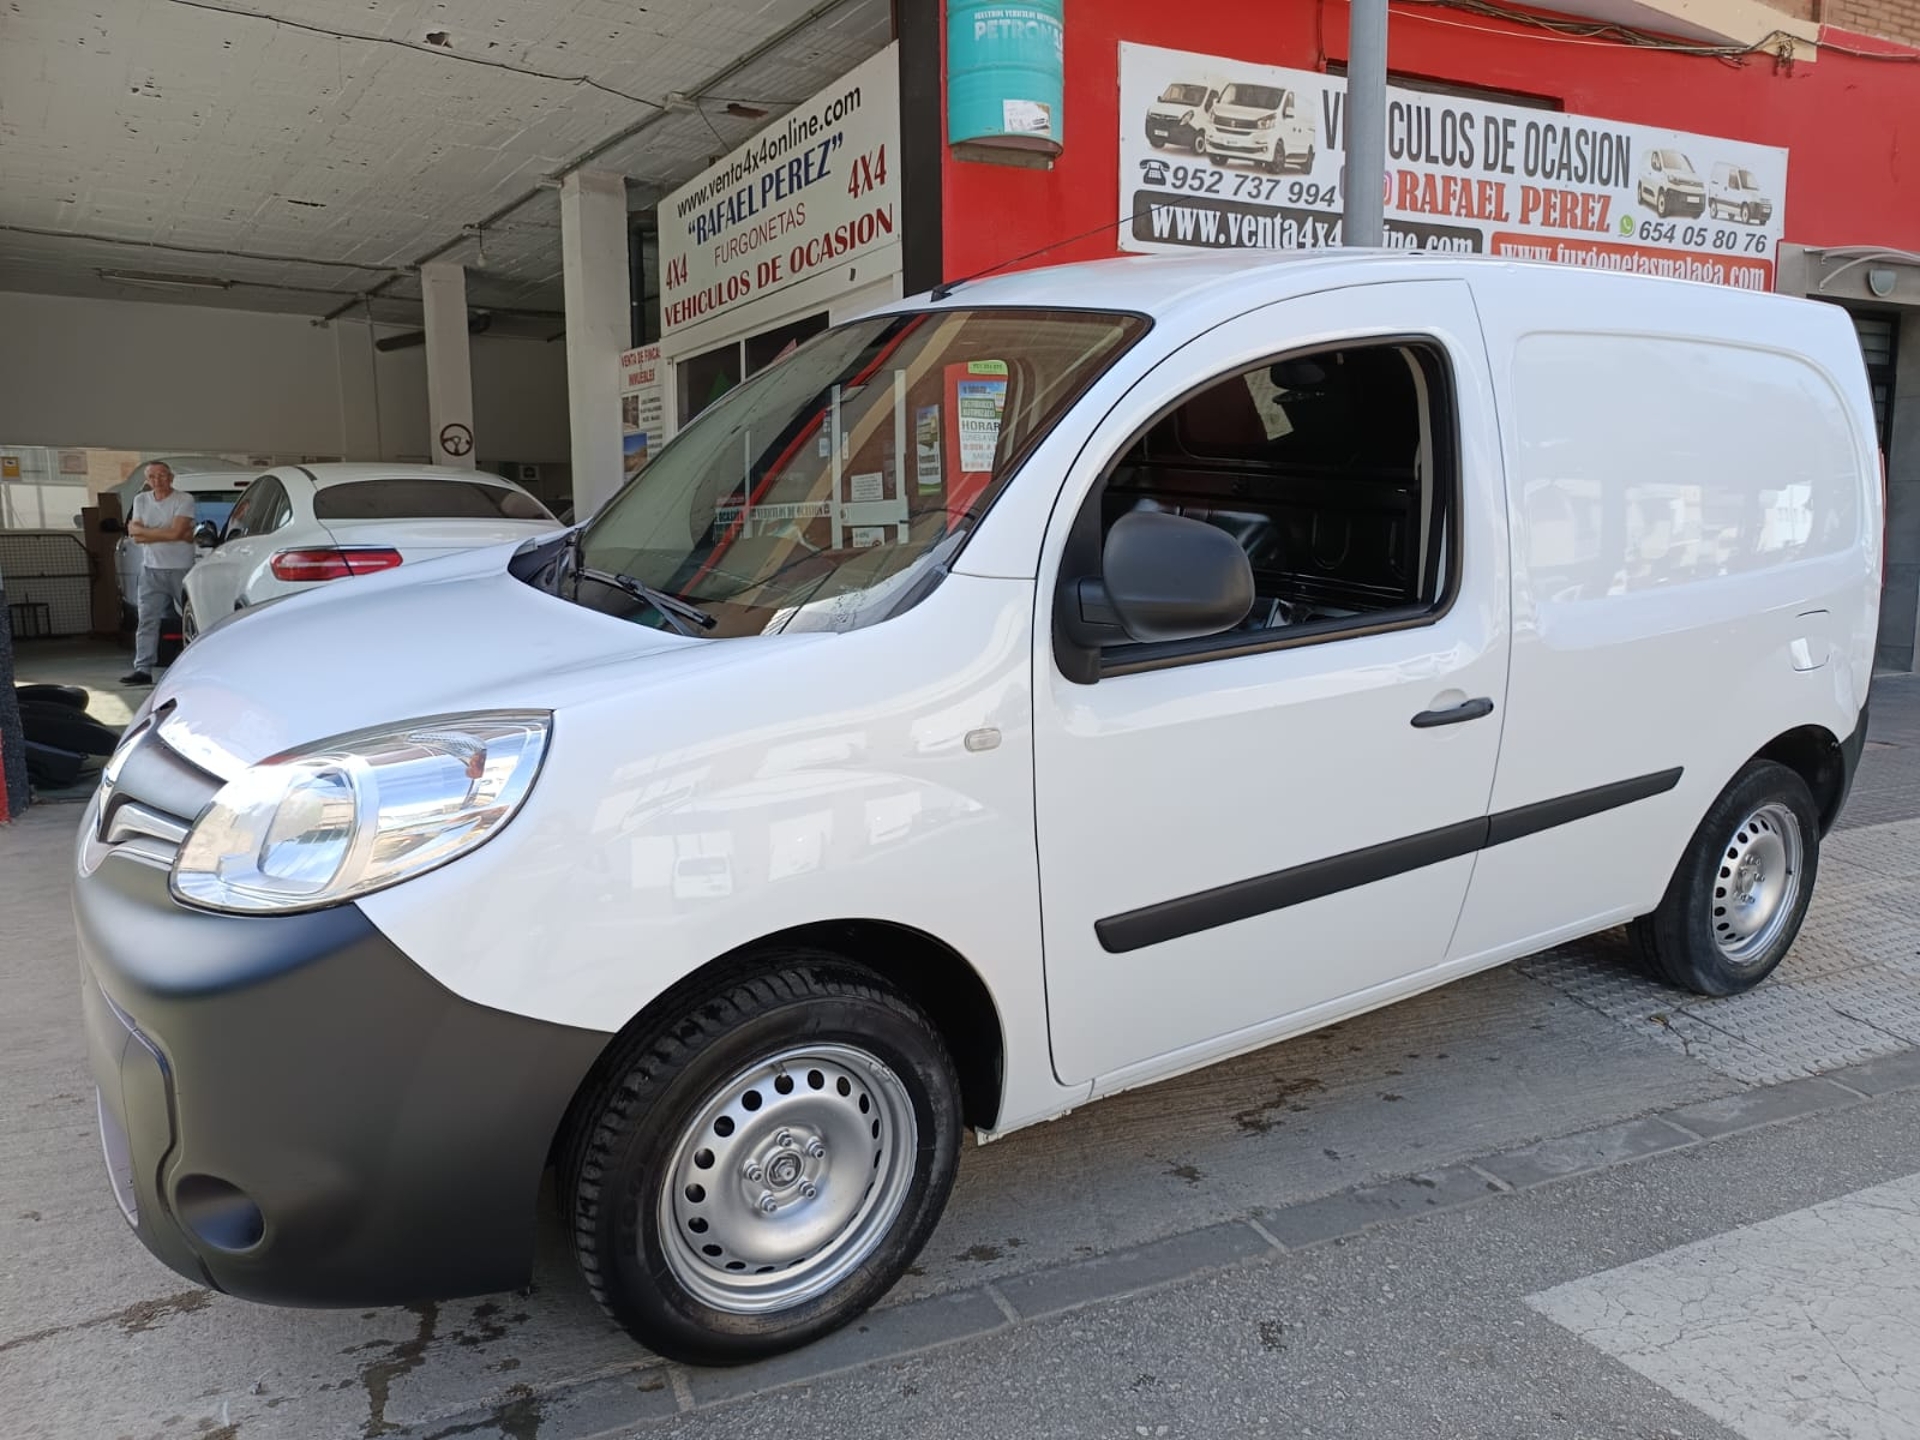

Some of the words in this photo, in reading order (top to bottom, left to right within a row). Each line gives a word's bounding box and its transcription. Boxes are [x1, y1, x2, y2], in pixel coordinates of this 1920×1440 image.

[677, 86, 861, 219] www.venta4x4online.com
[1322, 89, 1474, 170] VCULOS
[1483, 115, 1517, 175] DE
[1524, 120, 1631, 189] OCASION
[848, 144, 887, 199] 4X4
[1171, 165, 1223, 195] 952
[1233, 173, 1281, 201] 737
[1287, 180, 1336, 208] 994
[1396, 169, 1509, 222] RAFAEL
[1518, 184, 1612, 233] PEREZ
[664, 270, 751, 327] VEHICULOS
[757, 254, 782, 290] DE
[790, 203, 893, 275] OCASION
[714, 202, 806, 268] FURGONETAS
[1639, 220, 1675, 244] 654
[1682, 226, 1706, 247] 05
[1712, 229, 1737, 251] 80
[1746, 232, 1767, 254] 76
[665, 252, 688, 291] 4X4
